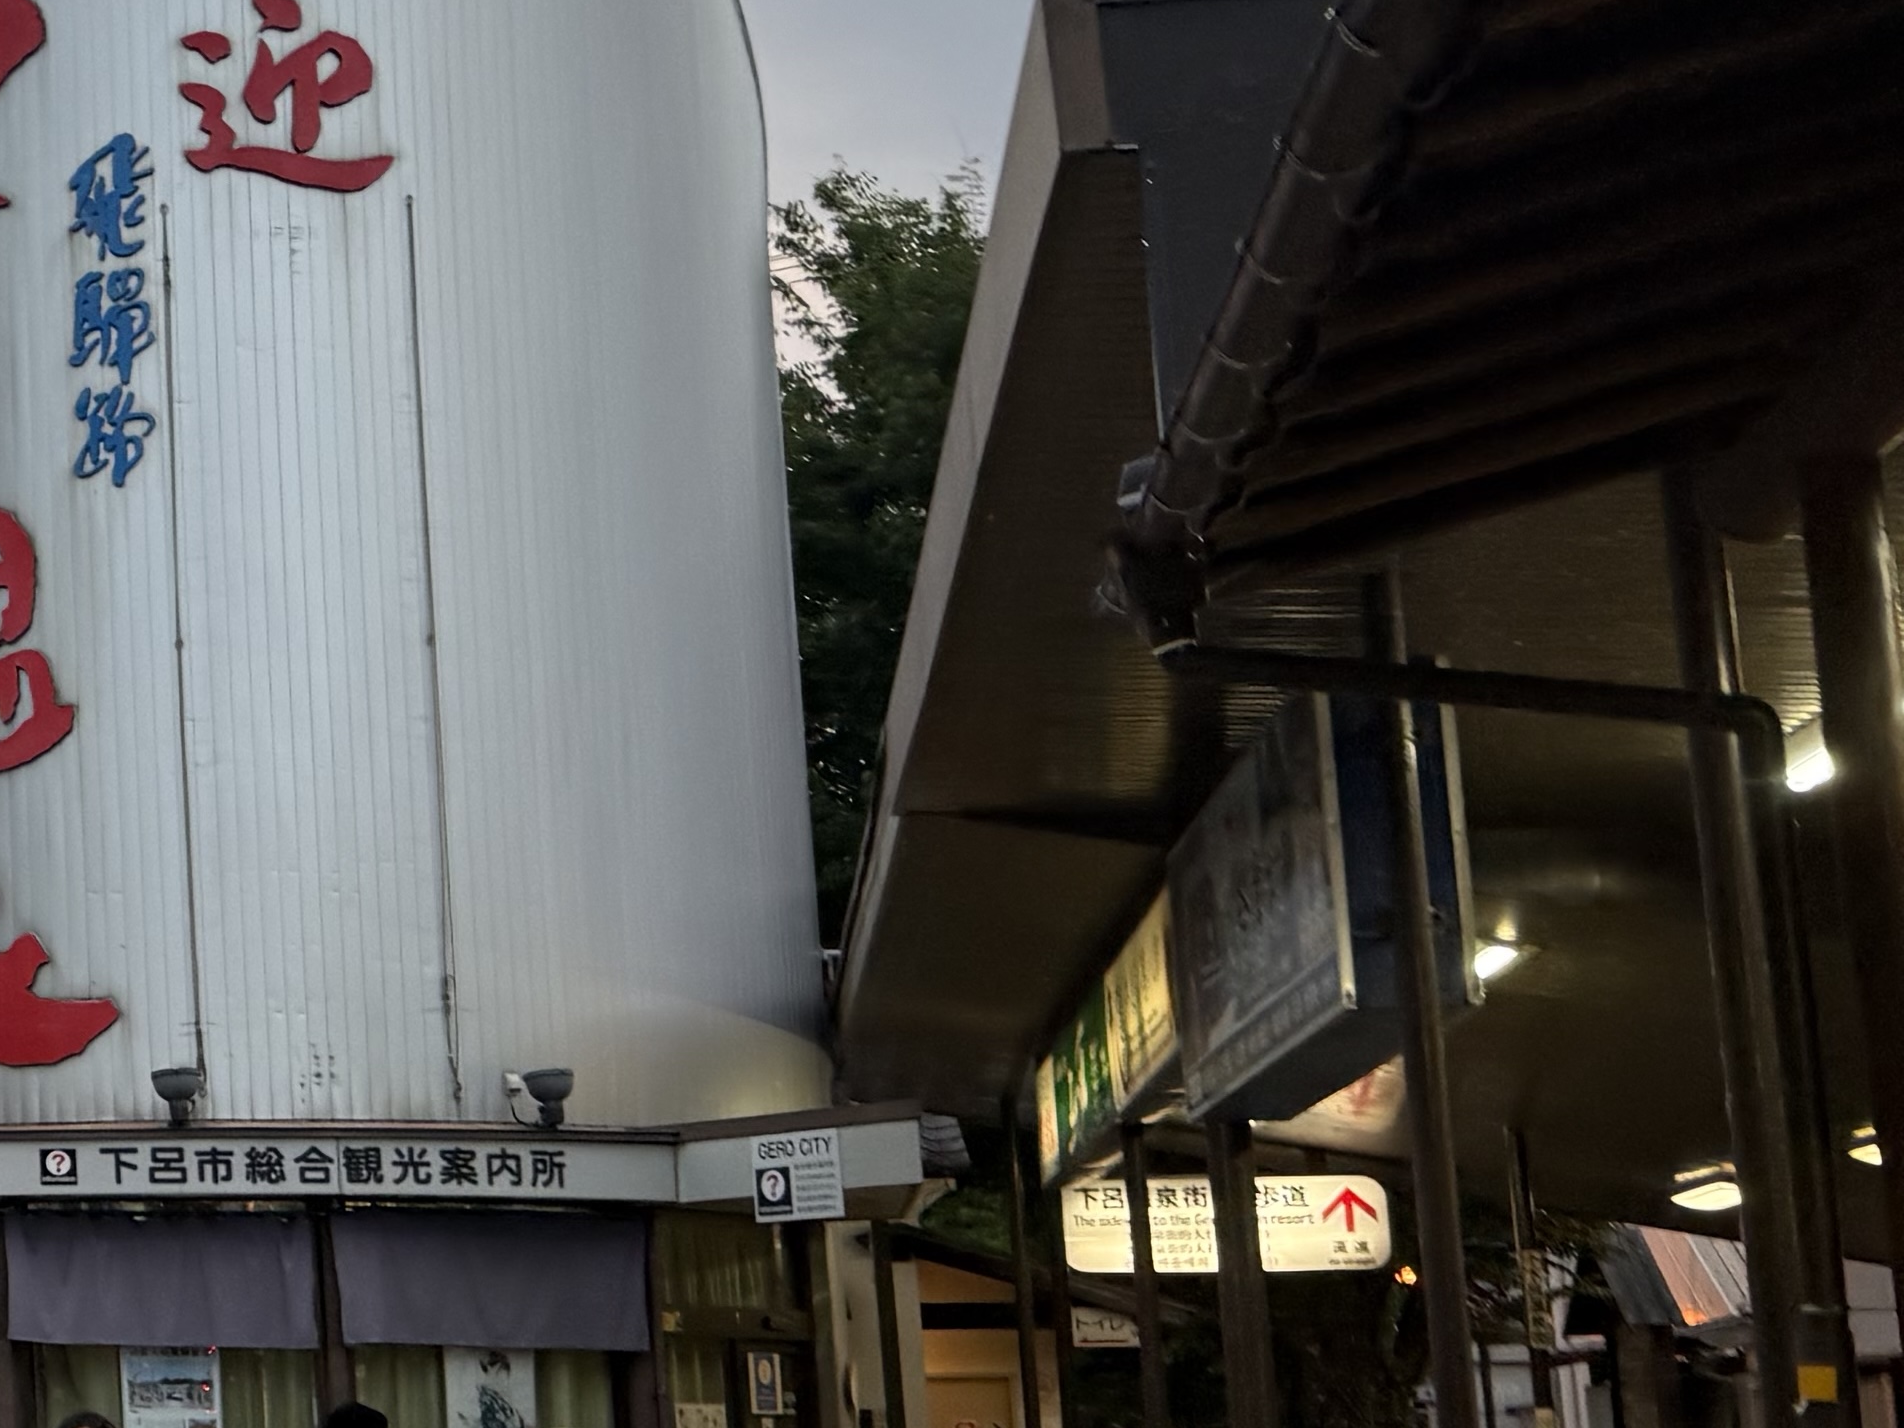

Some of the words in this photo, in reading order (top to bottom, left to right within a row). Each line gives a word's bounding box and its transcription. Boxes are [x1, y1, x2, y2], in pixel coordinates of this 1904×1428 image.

[758, 1139, 795, 1160] GERO
[799, 1136, 831, 1156] CITY
[99, 1147, 567, 1188] 下呂市総合観光案内所
